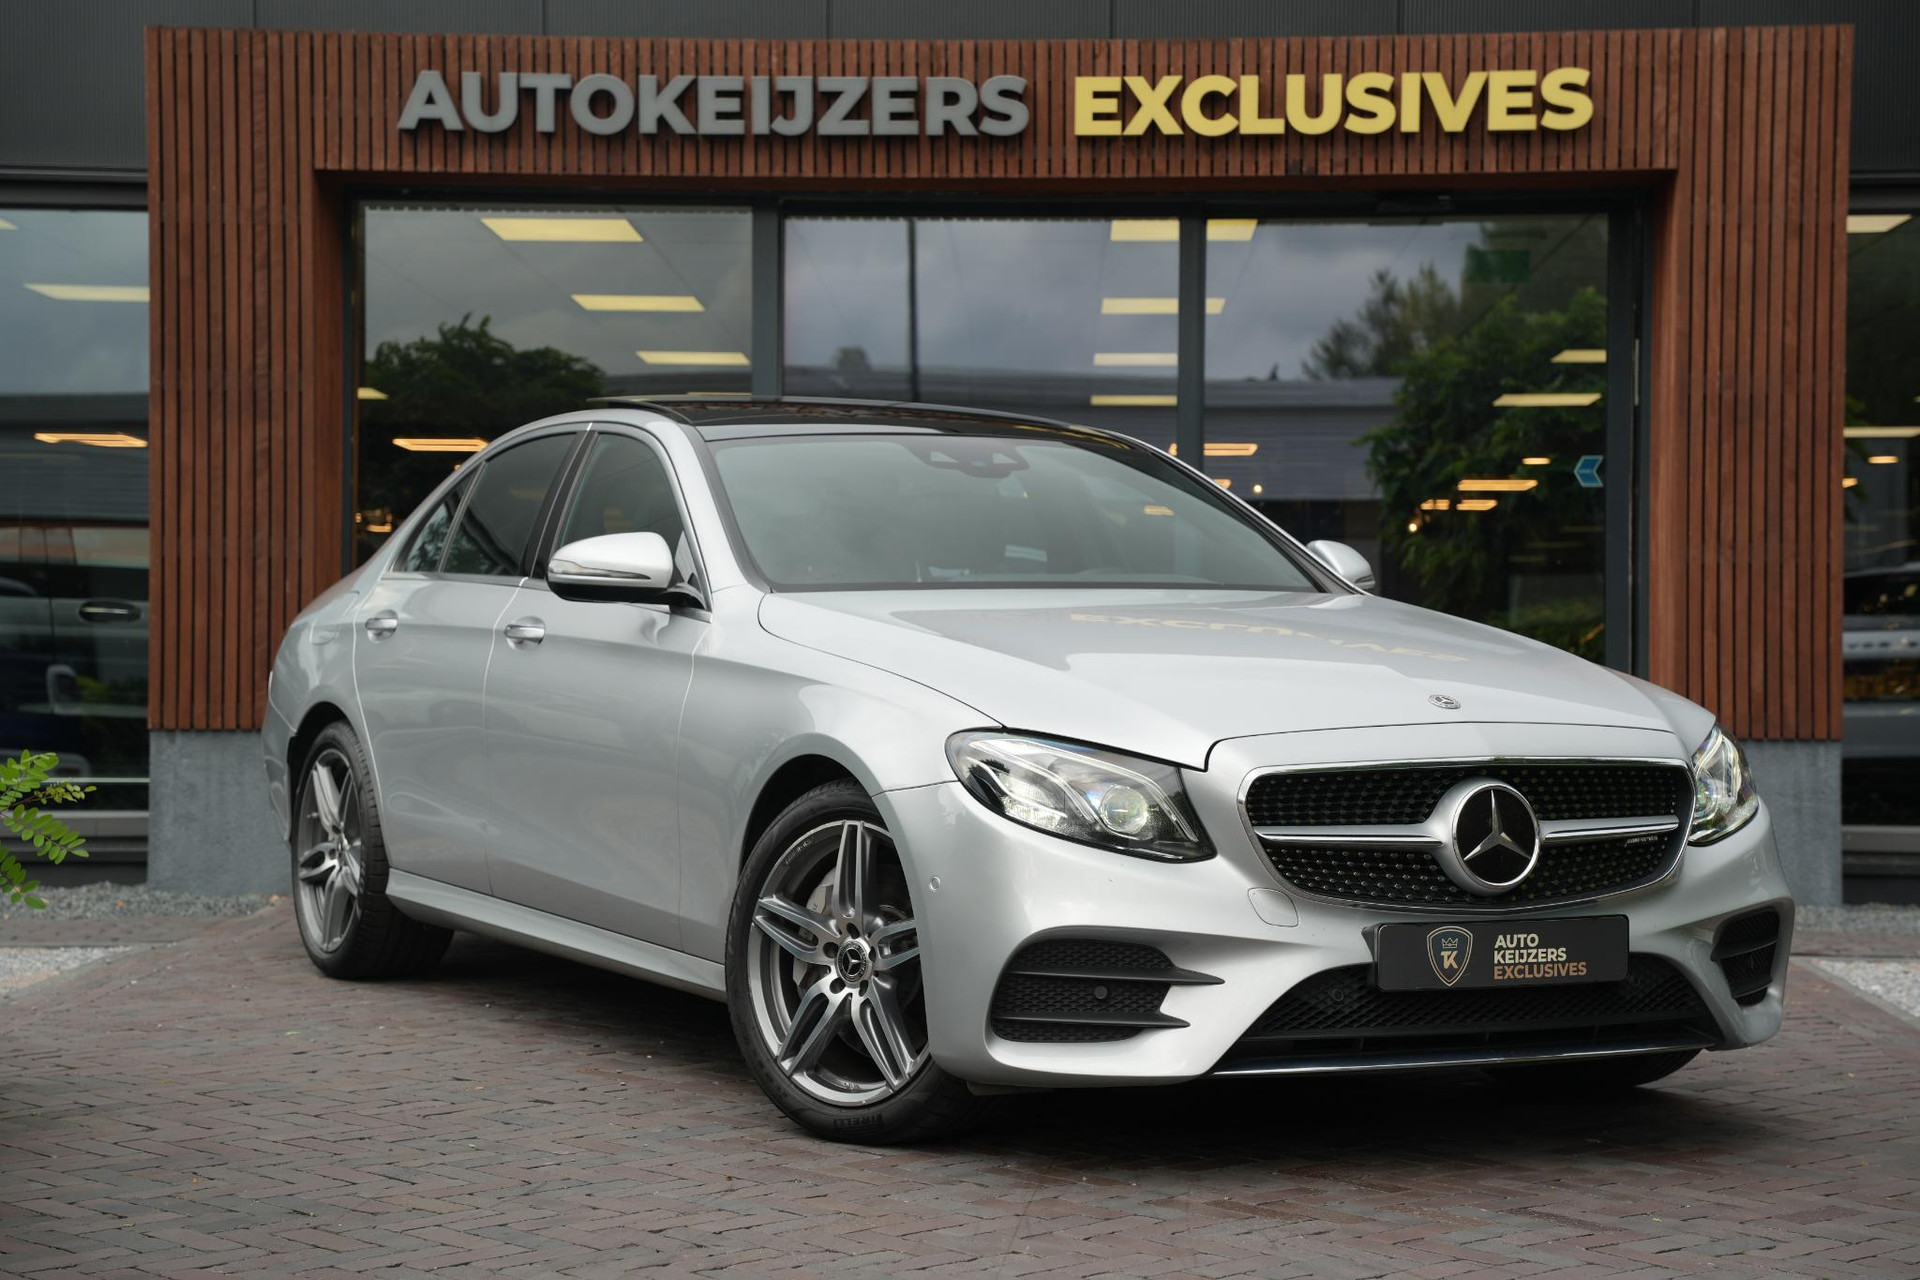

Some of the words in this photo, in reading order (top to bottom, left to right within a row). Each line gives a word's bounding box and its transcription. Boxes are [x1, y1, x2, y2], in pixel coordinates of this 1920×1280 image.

[397, 69, 1030, 137] AUTOKEIJZERS
[1074, 67, 1595, 136] EXCLUSIVES
[1494, 933, 1540, 949] AUTO
[1493, 948, 1567, 964] KEIJZERS
[1493, 961, 1588, 980] EXCLUSIVES
[832, 1113, 884, 1127] PIRELLI
